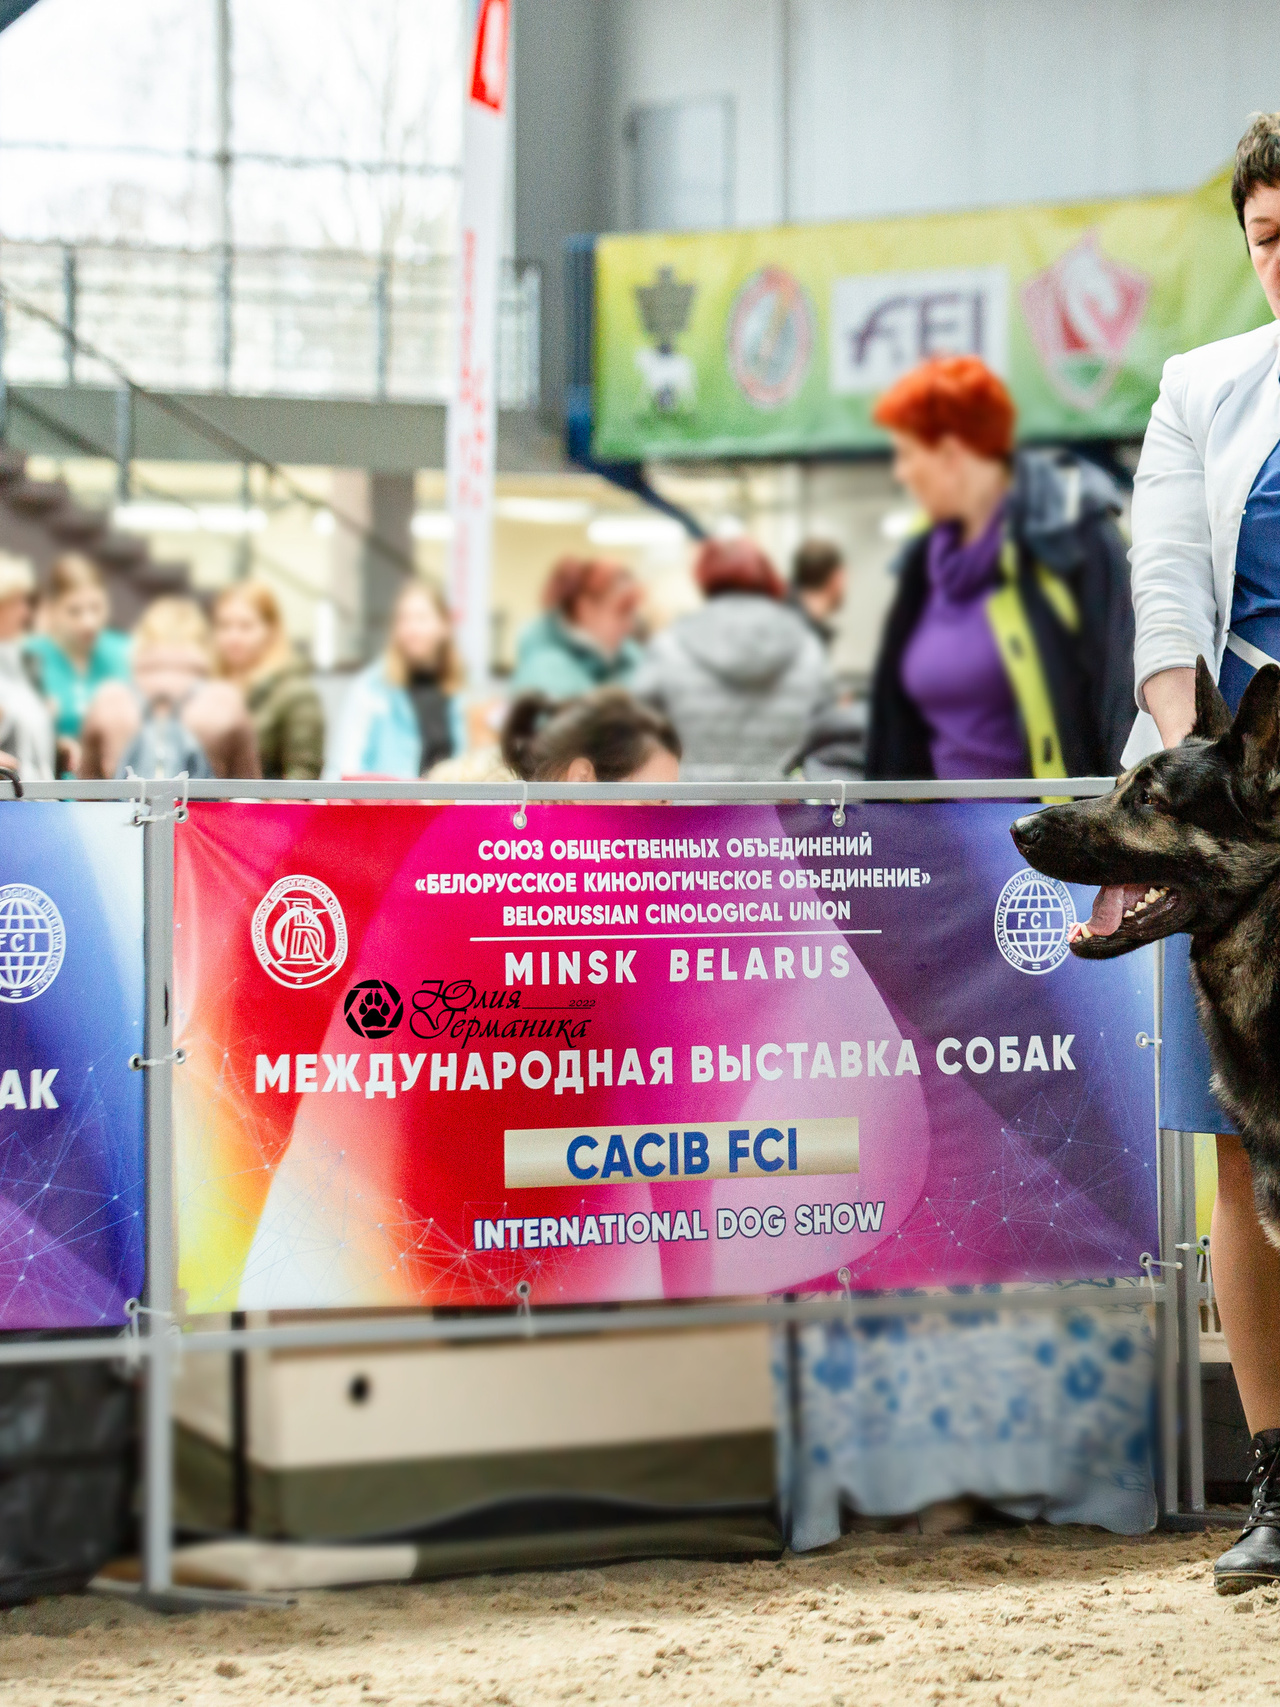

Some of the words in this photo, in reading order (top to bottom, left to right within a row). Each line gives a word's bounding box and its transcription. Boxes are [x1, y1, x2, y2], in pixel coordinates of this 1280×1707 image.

[478, 840, 544, 861] СОЮЗ
[550, 837, 721, 861] ОБЩЕСТВЕННЫХ
[726, 831, 873, 859] ОБЪЕДИНЕНИЙ
[415, 872, 577, 895] «БЕЛОРУССКОЕ
[583, 869, 772, 892] КИНОЛОГИЧЕСКОЕ
[778, 867, 931, 891] ОБЪЕДИНЕНИЕ»
[502, 903, 639, 927] BELORUSSIAN
[645, 902, 782, 924] CINOLOGICAL
[789, 900, 851, 922] UNION
[1017, 912, 1051, 929] FCI
[505, 950, 638, 986] MINSK
[669, 945, 851, 983] BELARUS
[254, 1044, 674, 1098] МЕЖДУНАРОДНАЯ
[691, 1039, 922, 1084] ВЫСТАВКА
[935, 1034, 1078, 1076] СОБАК
[565, 1132, 709, 1181] CACIB
[728, 1128, 800, 1174] FCI
[473, 1207, 707, 1251] INTERNATIONAL
[716, 1206, 785, 1240] DOG
[793, 1202, 886, 1236] SHOW
